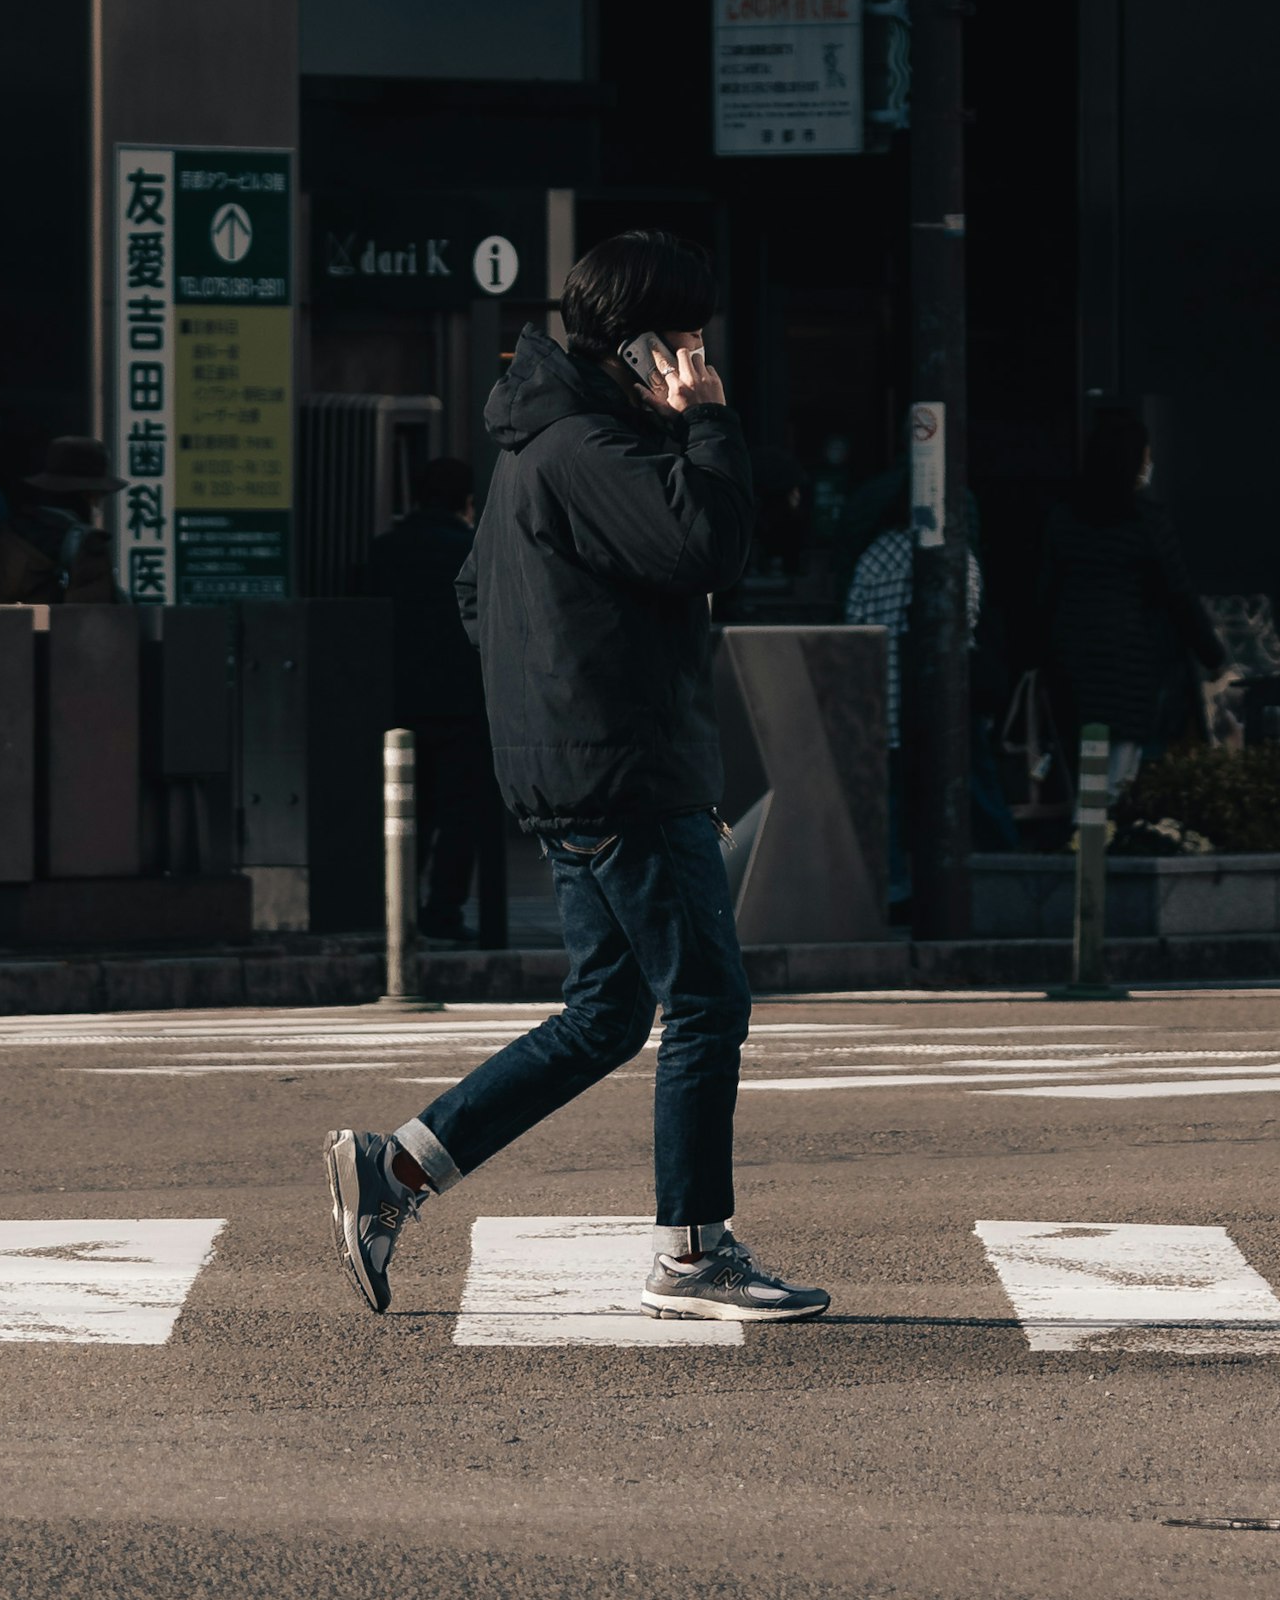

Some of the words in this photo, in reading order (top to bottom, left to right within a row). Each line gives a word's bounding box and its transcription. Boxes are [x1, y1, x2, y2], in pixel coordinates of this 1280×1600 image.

[426, 238, 452, 276] K
[126, 167, 166, 604] 友愛吉田歯科医
